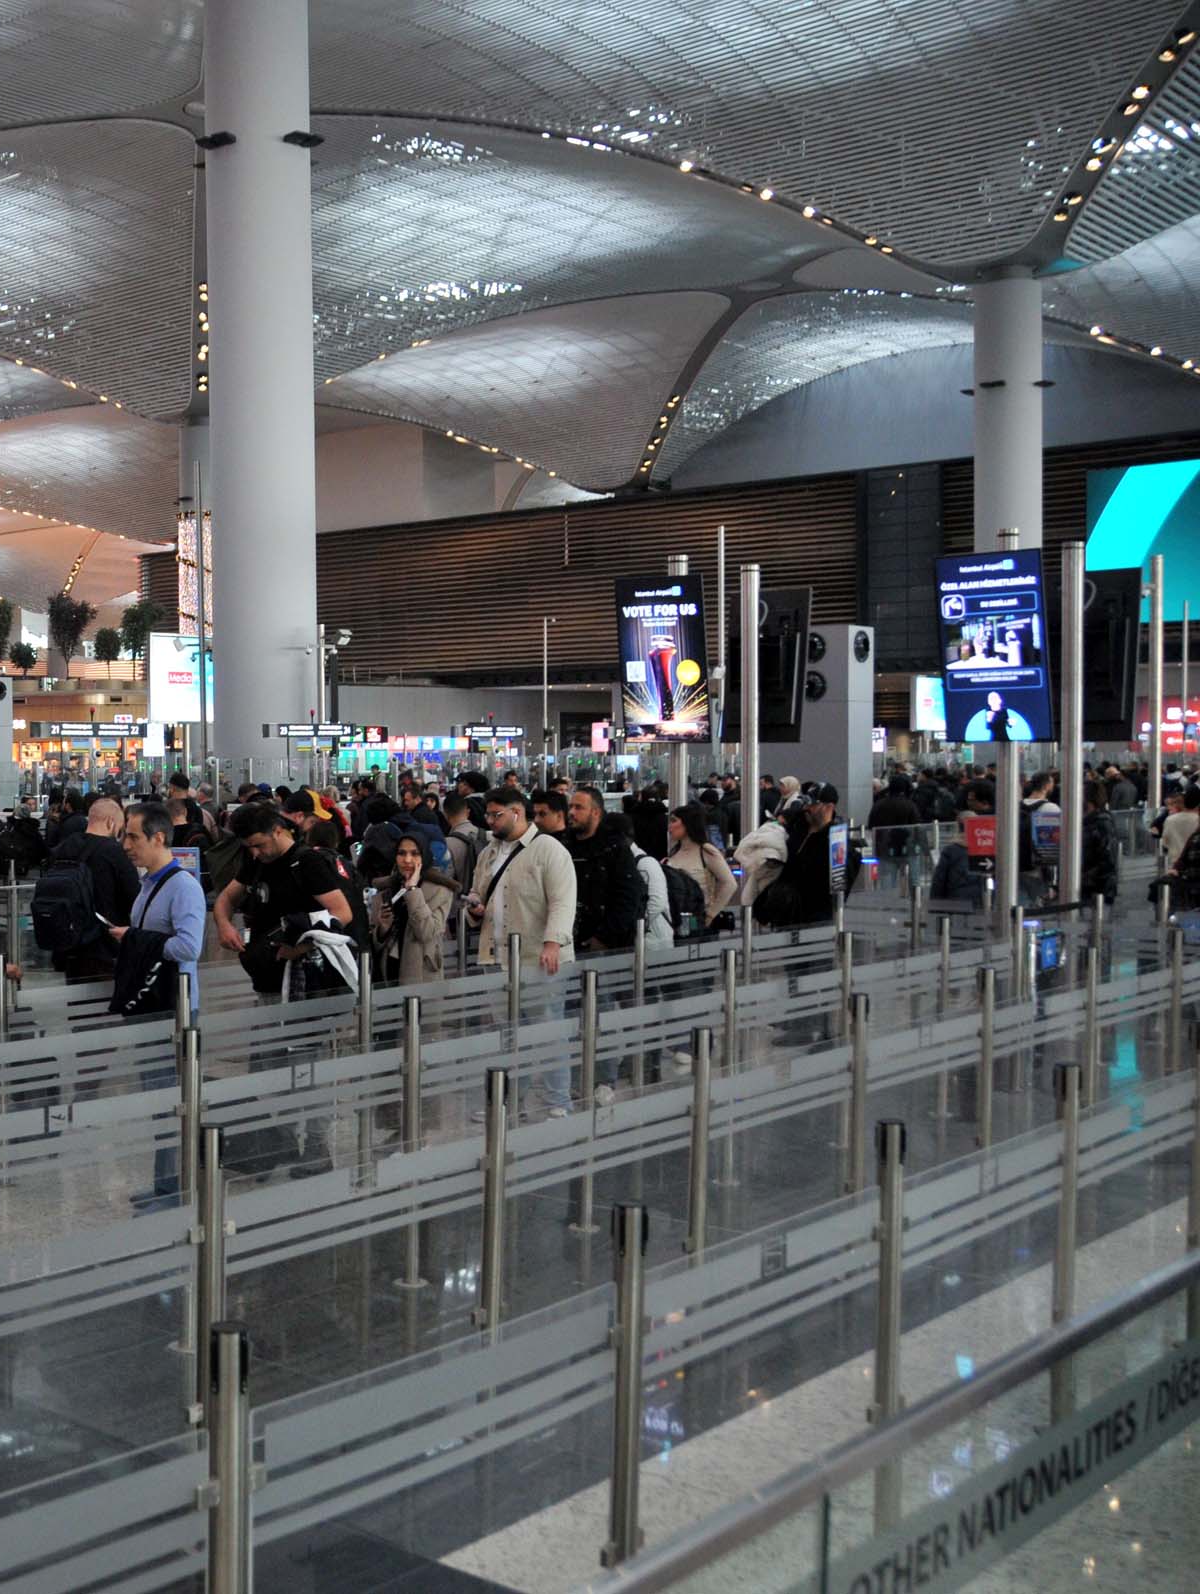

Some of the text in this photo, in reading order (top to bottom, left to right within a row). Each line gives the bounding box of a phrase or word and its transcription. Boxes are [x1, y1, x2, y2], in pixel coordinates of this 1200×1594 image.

[622, 603, 697, 618] VOTE FOR US
[50, 724, 60, 735] 21
[130, 725, 139, 735] 22
[956, 1399, 1137, 1558] NATIONALITIES
